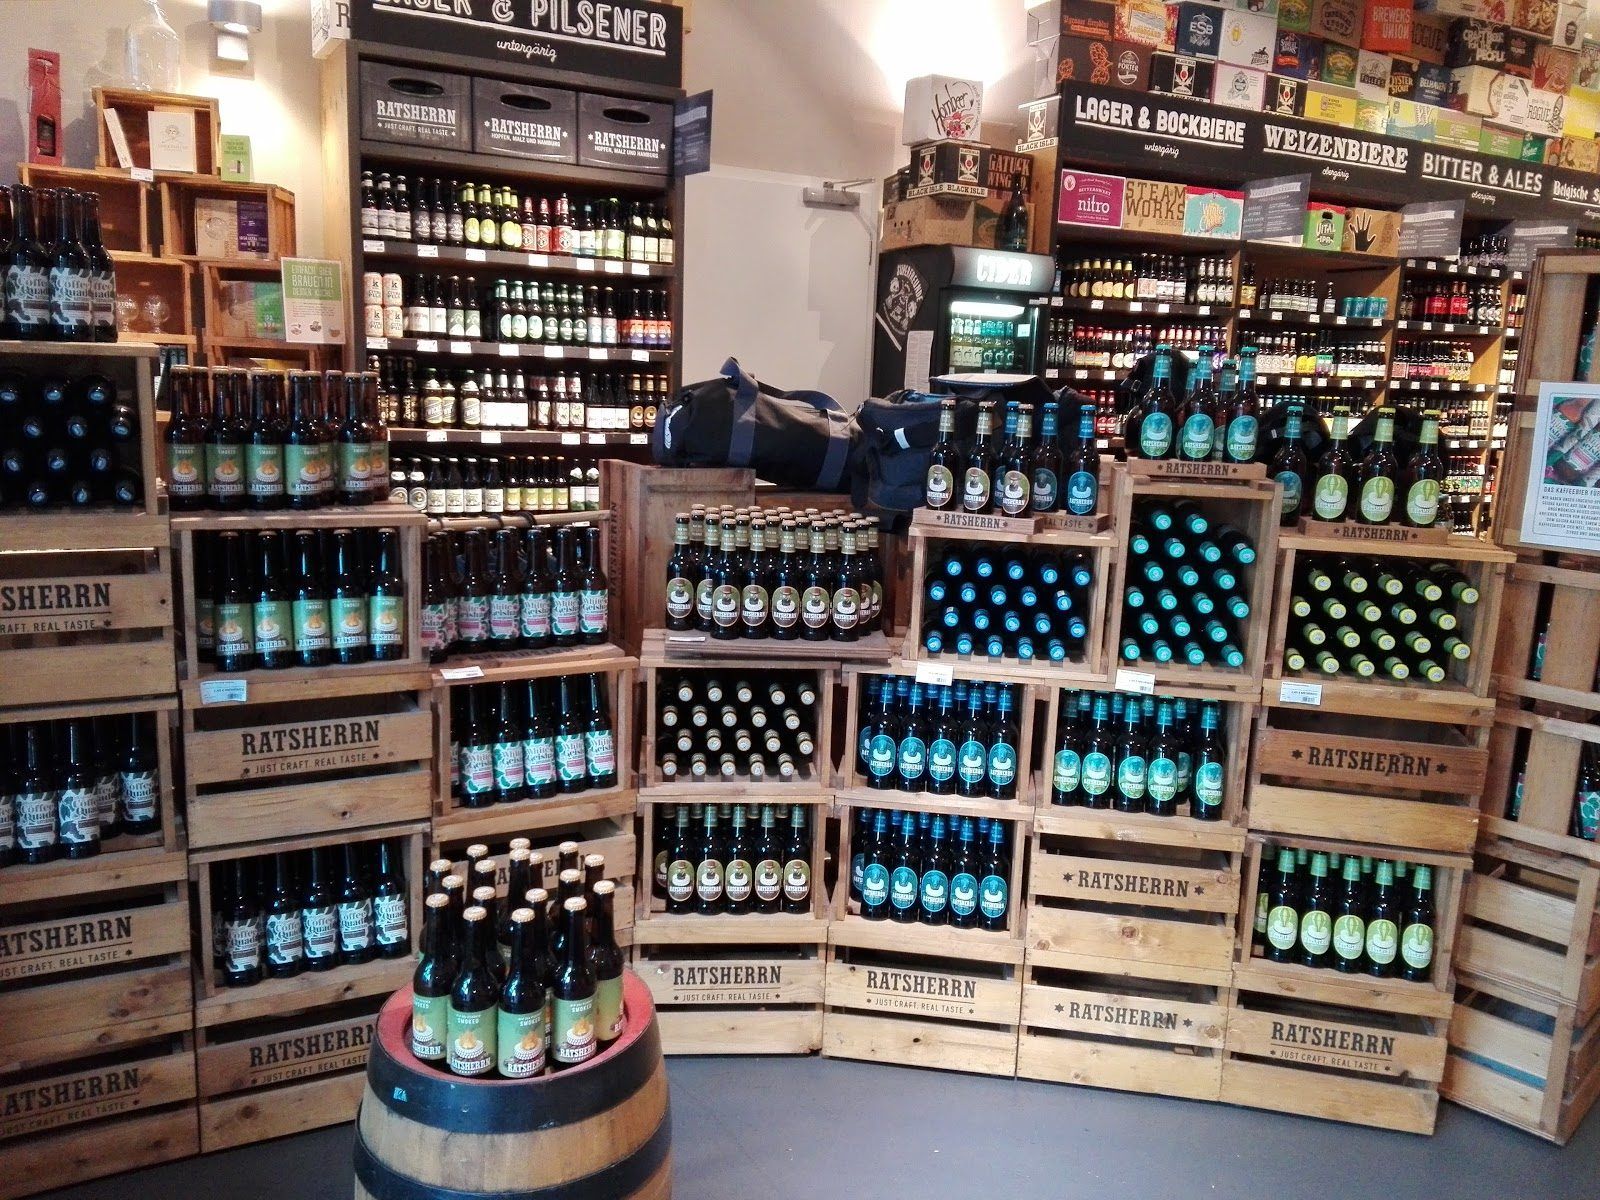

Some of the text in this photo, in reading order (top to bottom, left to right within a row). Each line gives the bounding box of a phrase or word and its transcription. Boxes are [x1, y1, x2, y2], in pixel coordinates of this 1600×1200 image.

[531, 0, 666, 48] PILSENER
[1373, 6, 1410, 23] BREWERS
[1189, 21, 1214, 35] ESB
[1382, 23, 1409, 39] UNION
[496, 40, 556, 62] untergärig
[1118, 63, 1139, 72] PORTER
[376, 100, 456, 124] RATSHERRN
[1076, 95, 1246, 144] LAGER & BOCKBIERE
[491, 118, 561, 140] RATSHERRN
[512, 135, 525, 143] MALZ
[594, 131, 659, 152] RATSHERRN
[1017, 139, 1055, 152] BLACK ISLE
[1144, 143, 1179, 158] untergärig
[1264, 123, 1408, 169] WEIZENBIERE
[1422, 152, 1543, 193] BITTER & ALES
[908, 187, 928, 197] BLACK
[947, 185, 986, 196] BLACK ISLE
[1553, 179, 1588, 200] Belgische
[1077, 194, 1110, 214] nitro
[1126, 199, 1185, 220] WORKS
[977, 254, 1033, 286] CIDER
[1166, 463, 1230, 476] RATSHERRN
[944, 513, 1001, 529] RATSHERRN
[1342, 527, 1409, 541] RATSHERRN
[33, 620, 61, 632] REAL
[241, 719, 379, 756] RATSHERRN
[255, 763, 277, 774] JUST
[314, 755, 337, 768] REAL
[1308, 746, 1431, 776] RATSHERRN
[1078, 870, 1189, 898] RATSHERRN
[21, 961, 56, 974] CRAFT.
[60, 956, 85, 967] REAL
[673, 965, 782, 986] RATSHERRN
[867, 970, 977, 999] RATSHERRN
[728, 992, 746, 1001] REAL
[875, 998, 892, 1007] JUST
[921, 1002, 939, 1012] REAL
[1068, 1002, 1178, 1030] RATSHERRN
[1271, 1021, 1395, 1056] RATSHERRN
[1279, 1050, 1298, 1060] JUST
[1331, 1057, 1353, 1067] REAL
[263, 1072, 282, 1083] JUST
[317, 1062, 338, 1071] REAL
